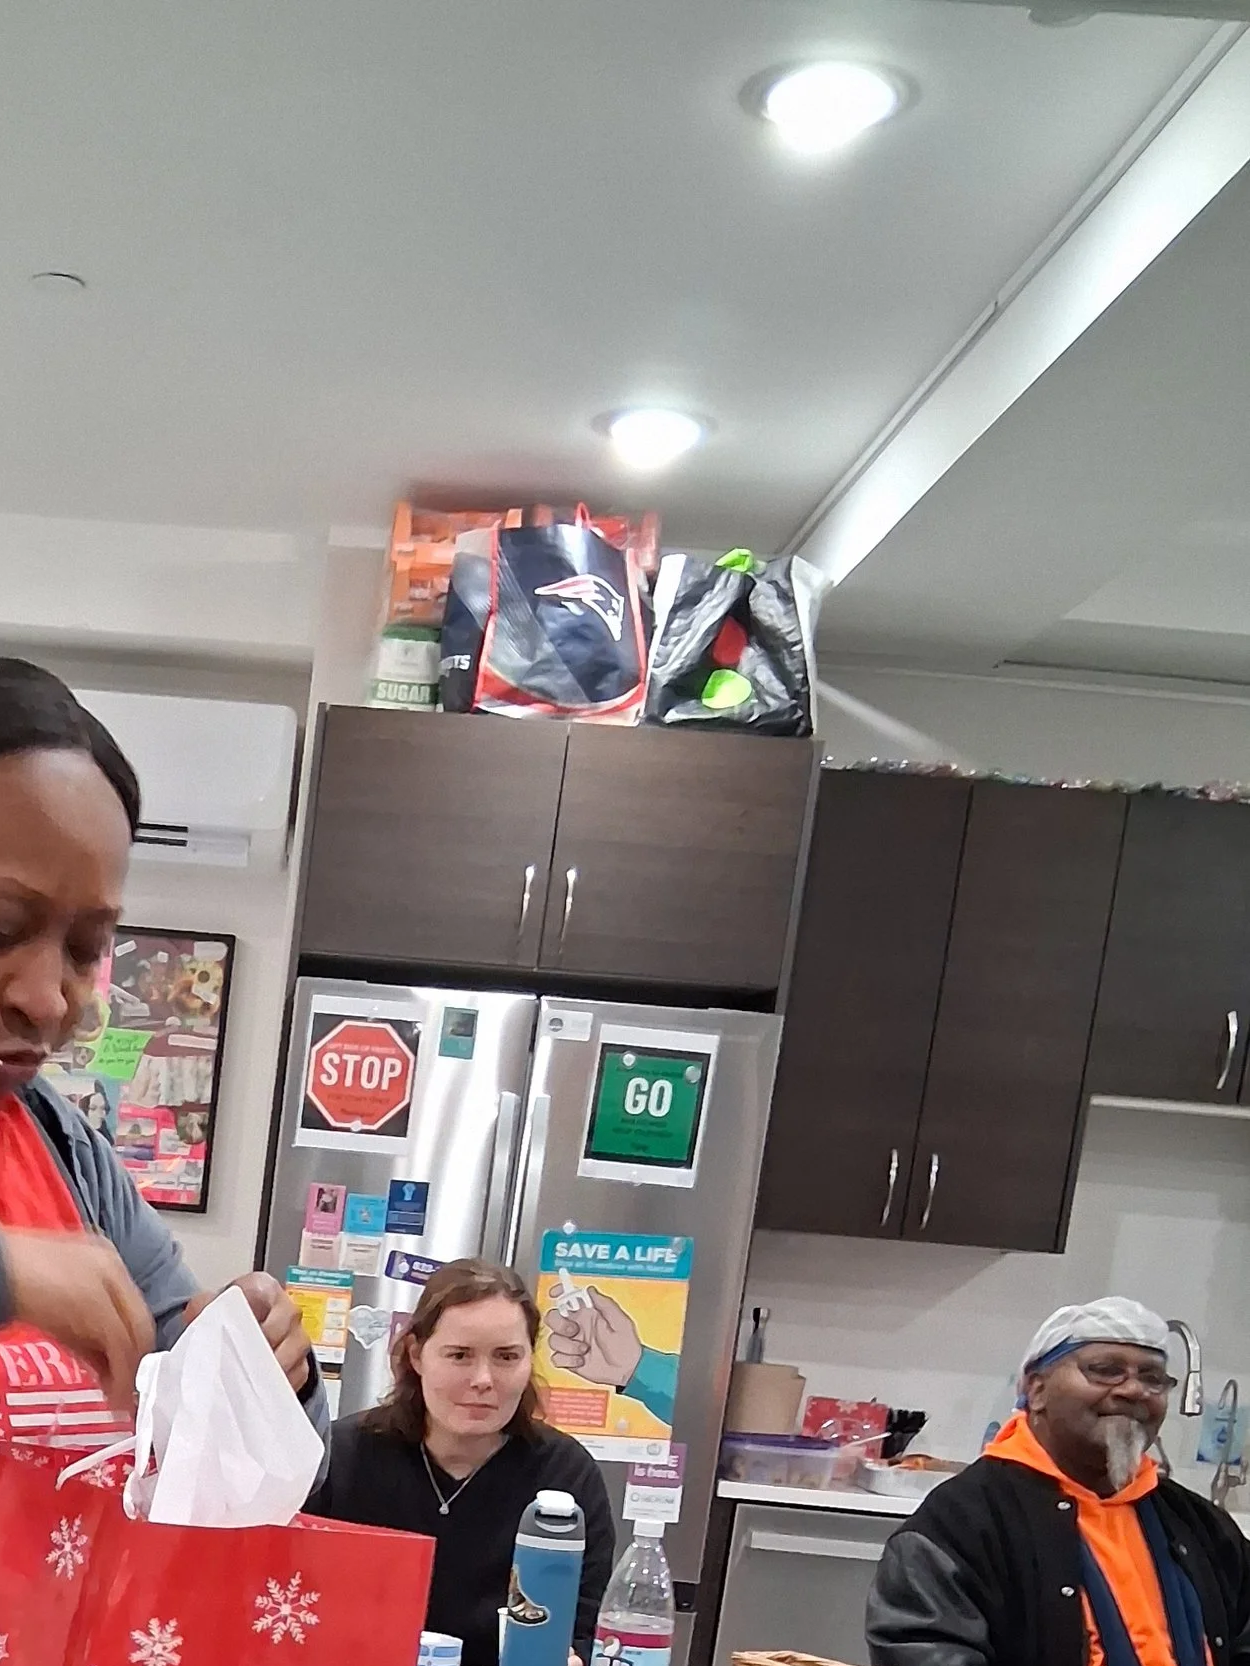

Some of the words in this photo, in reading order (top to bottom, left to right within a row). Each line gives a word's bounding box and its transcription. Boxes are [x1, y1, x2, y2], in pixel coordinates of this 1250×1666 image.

[376, 682, 430, 702] SUGAR
[319, 1052, 403, 1091] STOP
[624, 1077, 673, 1118] GO
[554, 1242, 611, 1260] SAVE
[614, 1245, 631, 1261] A
[634, 1246, 678, 1263] LIFE
